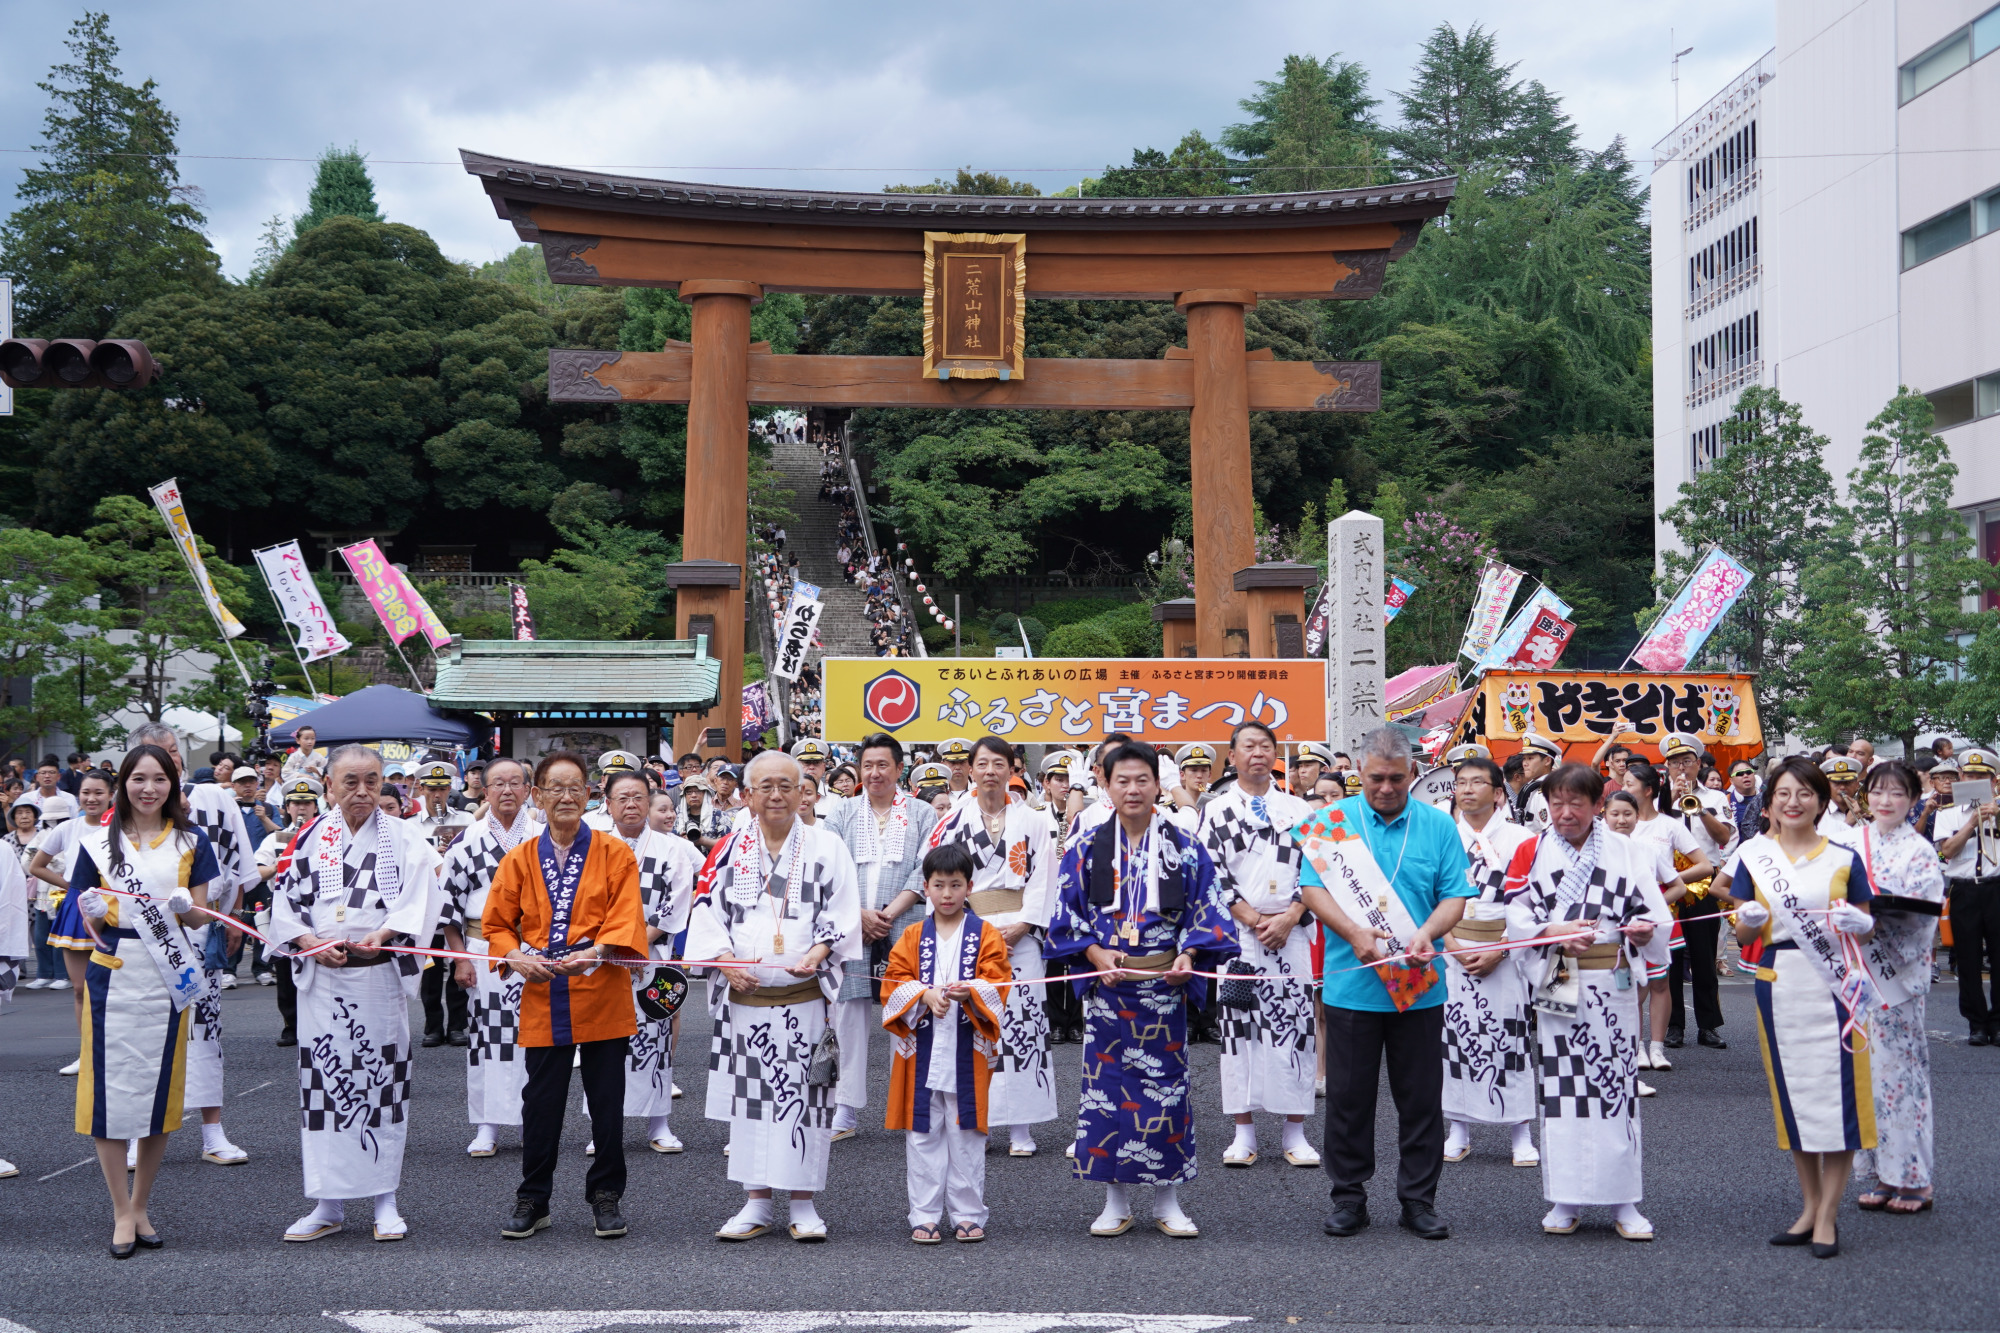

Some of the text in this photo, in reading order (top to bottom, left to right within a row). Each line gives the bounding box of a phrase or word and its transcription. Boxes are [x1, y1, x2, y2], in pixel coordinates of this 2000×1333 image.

[965, 264, 983, 348] 二荒山神社
[1483, 573, 1518, 637] バナナチョコ
[937, 668, 1109, 681] であいとふれあいの広場
[937, 686, 1289, 736] ふるさと宮まつり
[1509, 711, 1527, 732] 万両
[1536, 681, 1709, 735] やきそば
[1714, 715, 1731, 736] 万両
[383, 743, 410, 760] ¥500
[101, 839, 186, 970] のみや親善大使
[551, 854, 583, 943] ふるさと宮まつり
[181, 982, 198, 995] YEG
